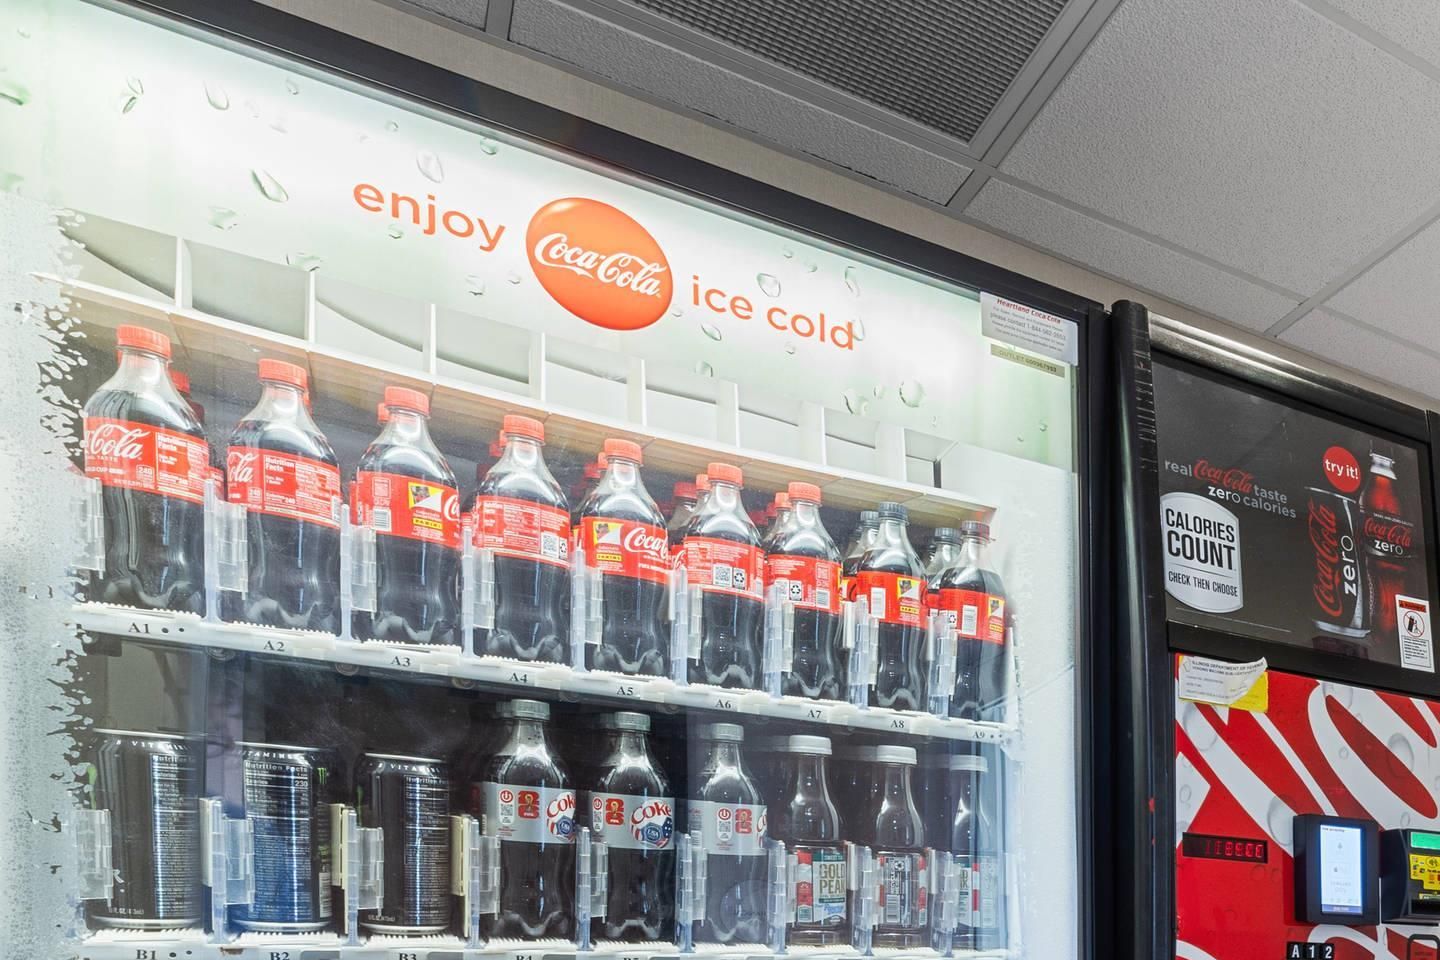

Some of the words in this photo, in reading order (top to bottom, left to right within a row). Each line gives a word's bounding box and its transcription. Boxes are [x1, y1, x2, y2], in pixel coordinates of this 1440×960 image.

[353, 183, 505, 252] enjoy
[534, 232, 667, 299] Coca-Cola
[691, 276, 753, 320] ice
[767, 307, 856, 351] cold
[90, 423, 151, 459] Cola
[1325, 458, 1344, 477] try
[1346, 464, 1359, 480] it!
[1165, 459, 1192, 477] real
[1193, 458, 1254, 494] Coca-Cola
[1254, 484, 1288, 503] taste
[1208, 486, 1241, 503] zero
[1243, 494, 1297, 518] calories
[1165, 508, 1235, 543] CALORIES
[1364, 517, 1413, 548] Coca-Cola
[1167, 530, 1236, 571] COUNT
[1308, 499, 1343, 617] Coca-Cola
[1373, 539, 1404, 556] zero
[1341, 535, 1356, 597] zero
[1168, 570, 1191, 586] CHECK
[1193, 576, 1210, 591] THEN
[1212, 581, 1238, 597] CHOOSE
[128, 622, 150, 635] A1
[263, 640, 285, 652] A2
[390, 655, 411, 667] A3
[508, 672, 528, 684] A4
[616, 685, 634, 697] A5
[715, 698, 732, 709] A6
[807, 709, 822, 720] A7
[890, 718, 905, 729] A8
[972, 730, 986, 740] A9
[135, 948, 157, 960] B1
[1292, 944, 1300, 958] A
[1309, 945, 1315, 958] 1
[1325, 946, 1332, 959] 2
